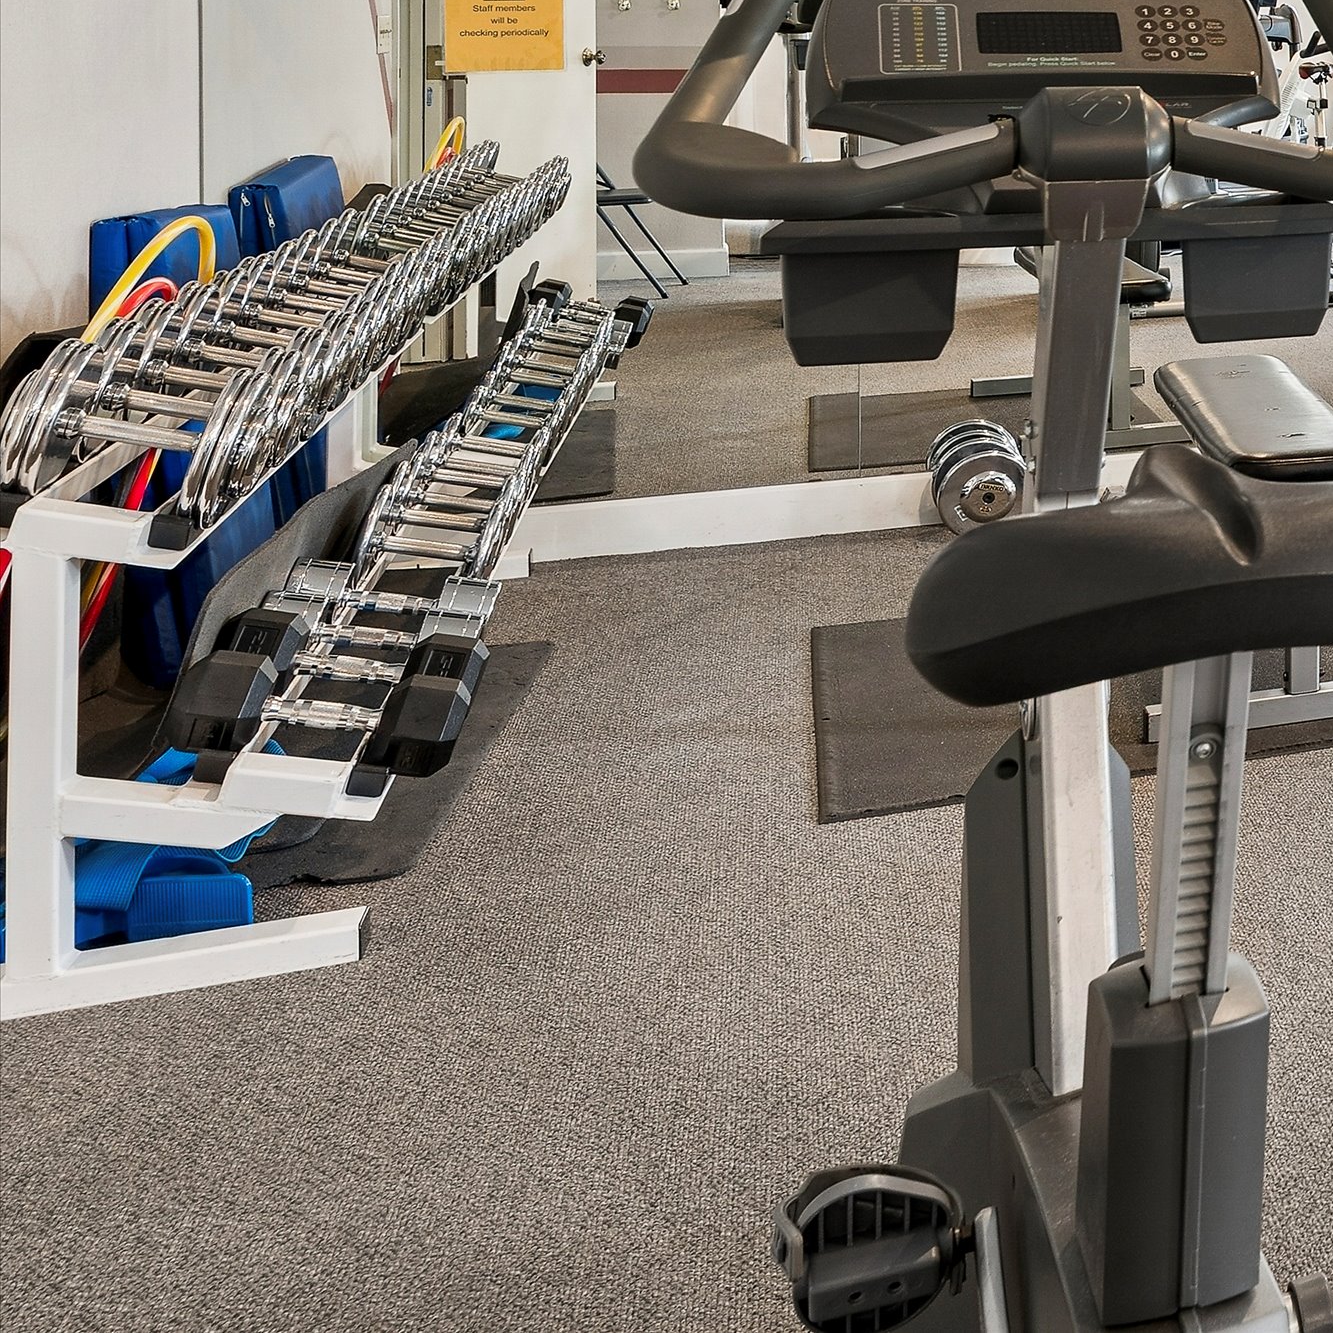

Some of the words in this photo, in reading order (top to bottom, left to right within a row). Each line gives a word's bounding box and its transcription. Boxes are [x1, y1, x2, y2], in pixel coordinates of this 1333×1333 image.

[1142, 8, 1149, 16] 1
[1163, 8, 1172, 16] 2
[1185, 8, 1194, 16] 3
[1143, 22, 1152, 30] 4
[500, 29, 549, 37] periodically
[1145, 36, 1154, 44] 7
[1168, 36, 1177, 44] 8
[1190, 36, 1199, 44] 9
[1170, 50, 1179, 58] 0
